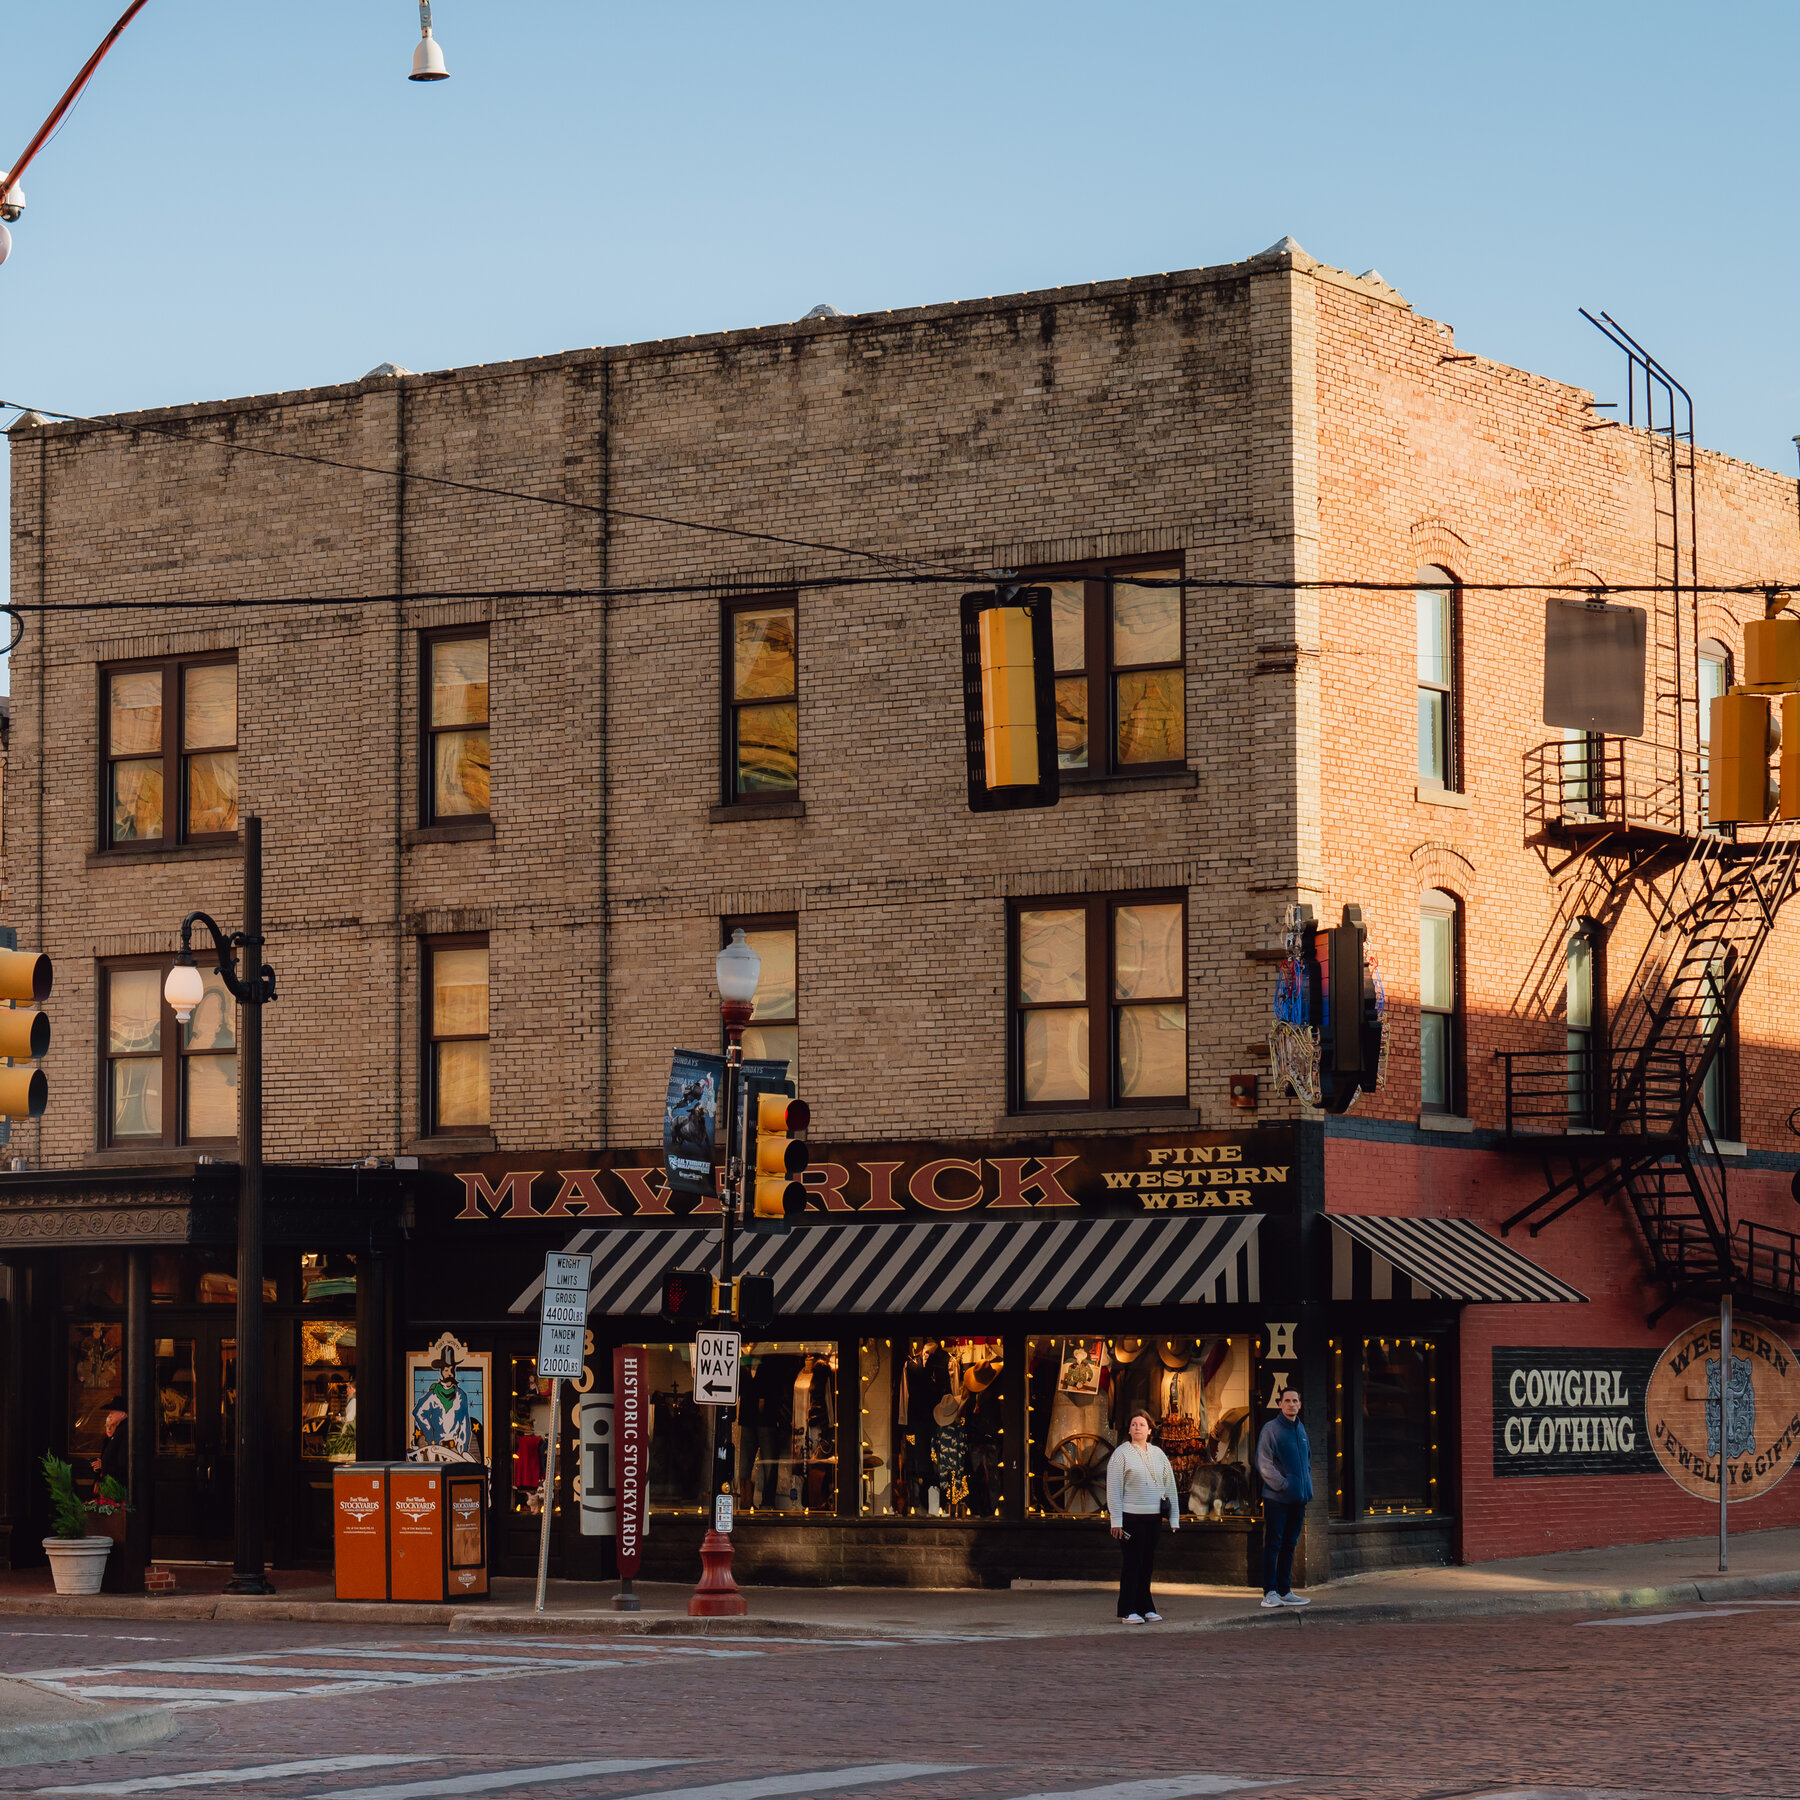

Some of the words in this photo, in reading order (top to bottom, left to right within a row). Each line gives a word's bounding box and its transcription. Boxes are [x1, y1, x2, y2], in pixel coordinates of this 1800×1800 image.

[1147, 1146, 1242, 1165] FINE
[1101, 1166, 1290, 1189] WESTERN
[1137, 1189, 1253, 1210] WEAR
[557, 1258, 581, 1269] WEIGHT
[556, 1275, 578, 1285] LIMITS
[555, 1292, 576, 1304] GROSS
[551, 1328, 576, 1340] TANDEM
[553, 1344, 570, 1355] AXLE
[701, 1339, 735, 1357] ONE
[700, 1358, 734, 1376] WAY
[1509, 1369, 1629, 1408] COWGIRL
[624, 1358, 638, 1439] HISTORIC
[1504, 1416, 1636, 1455] CLOTHING
[1742, 1462, 1753, 1483] &
[1755, 1412, 1800, 1476] GIFTS
[340, 1501, 380, 1510] STOCKYARDS
[396, 1501, 436, 1510] STOCKYARDS
[622, 1444, 638, 1556] STOCKYARDS
